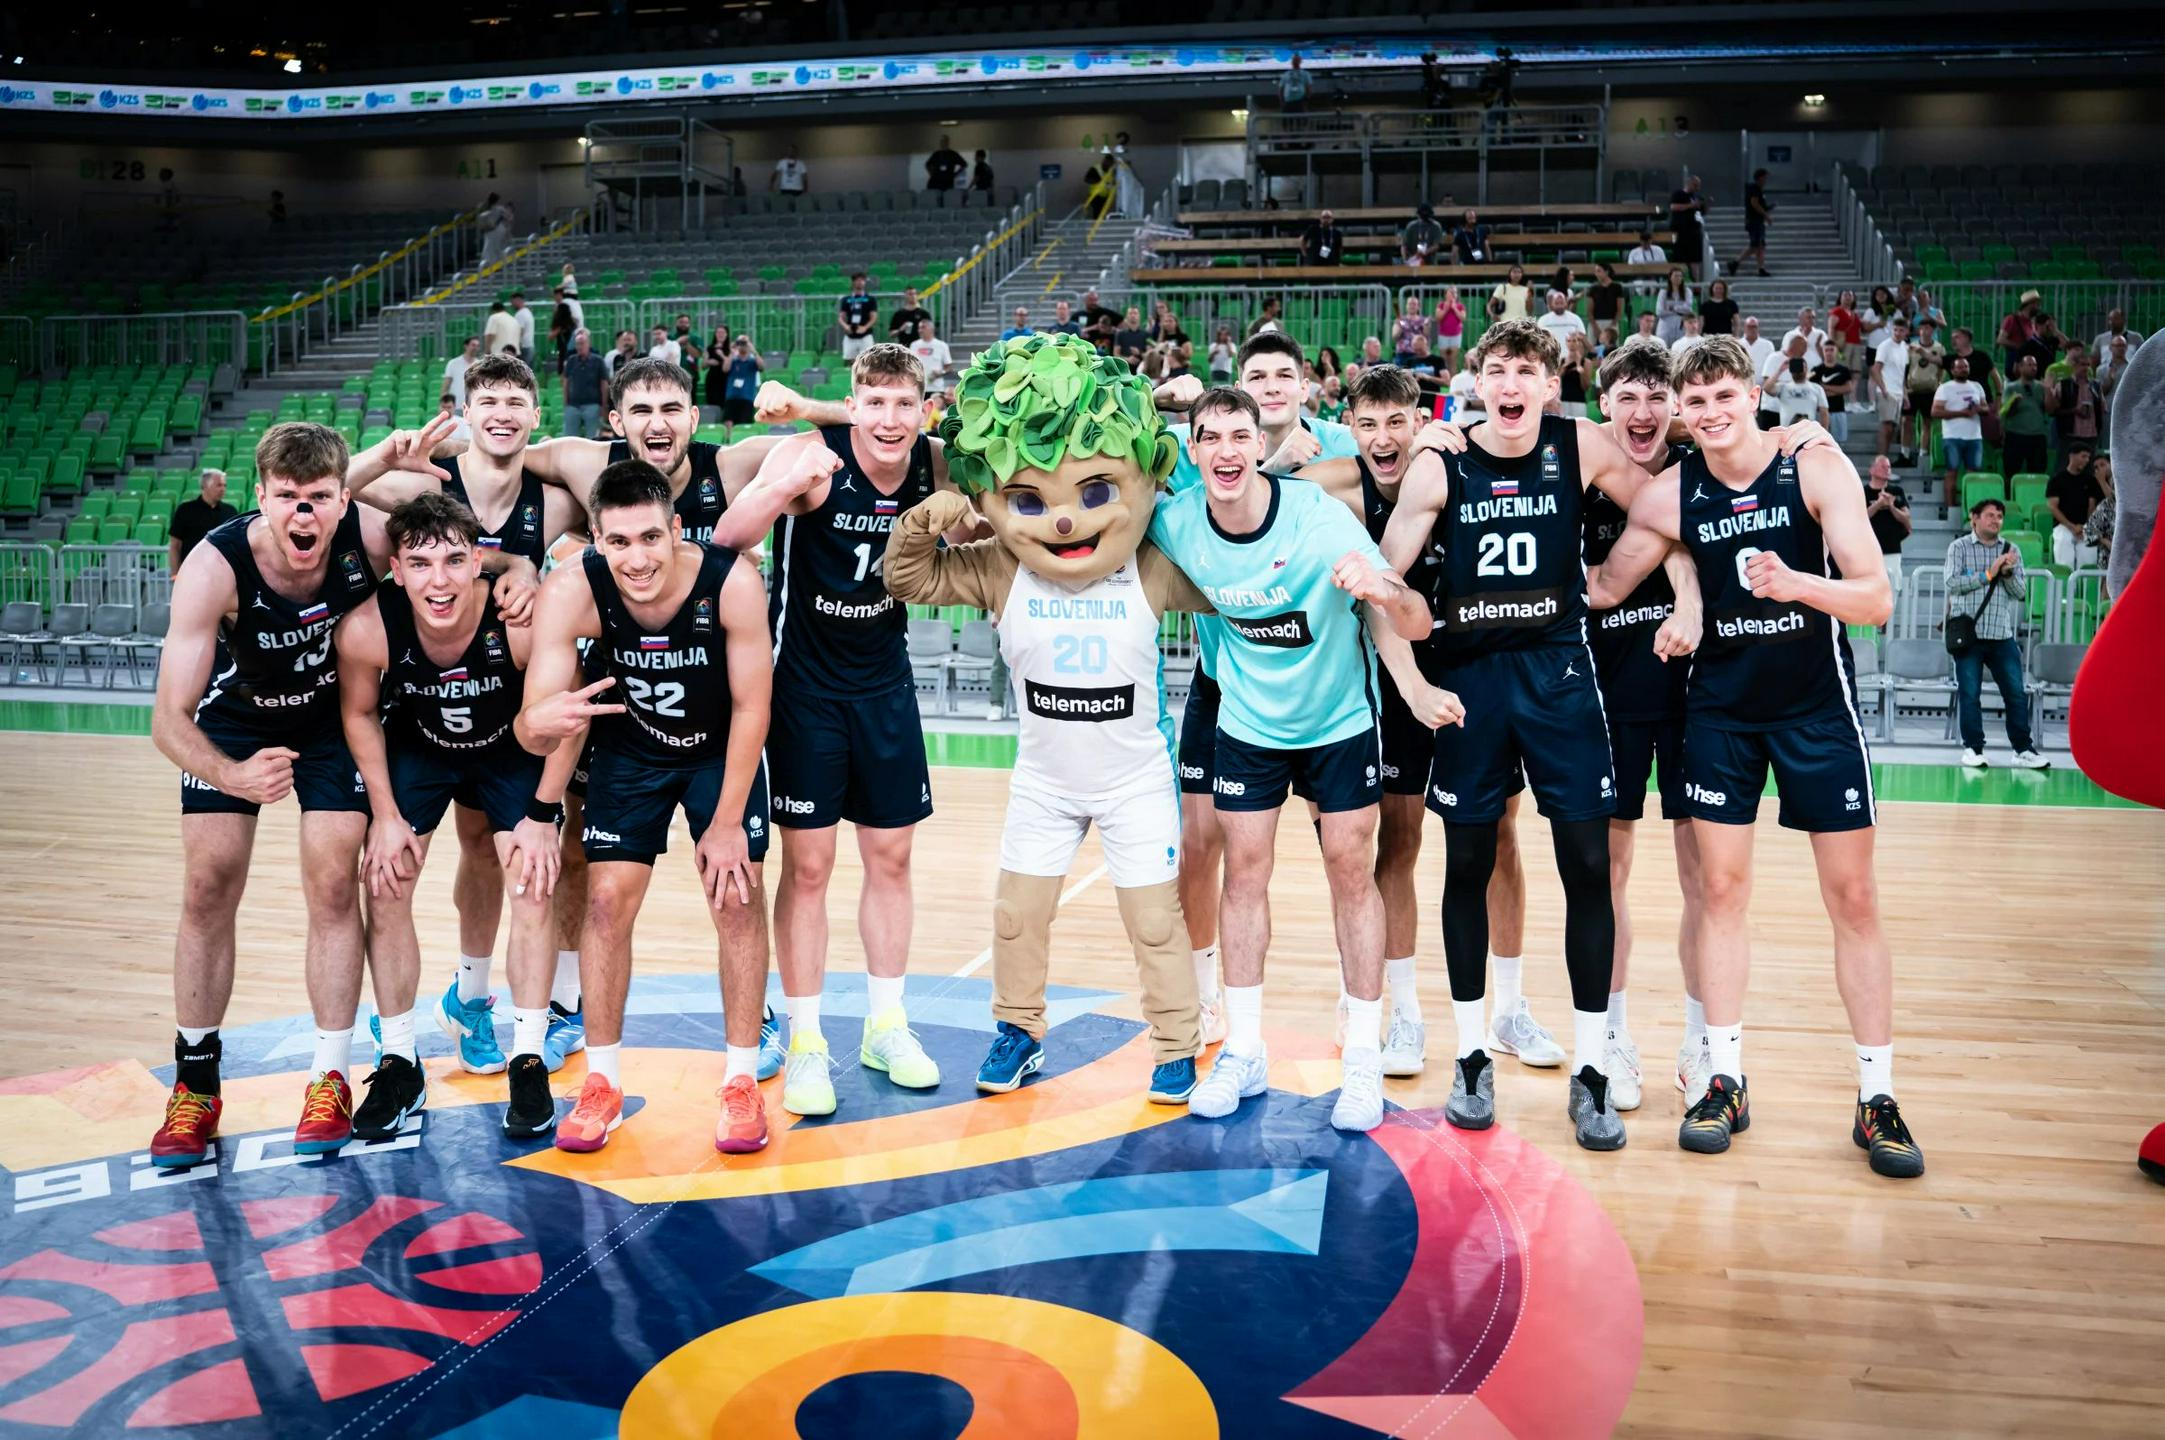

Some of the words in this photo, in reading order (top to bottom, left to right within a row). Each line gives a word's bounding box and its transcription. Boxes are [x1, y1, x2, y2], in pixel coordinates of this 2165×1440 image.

[118, 95, 140, 105] KZS
[1459, 494, 1558, 524] SLOVENIJA
[832, 512, 898, 533] SLOVE
[1697, 506, 1791, 543] SLOVENIJA
[1477, 532, 1537, 577] 20
[815, 593, 895, 619] telemach
[1028, 598, 1128, 620] SLOVENIJA
[1458, 596, 1558, 623] telemach
[1601, 603, 1674, 629] telemac
[258, 612, 344, 650] SLOVE
[1228, 619, 1301, 639] lemach
[614, 646, 709, 670] LOVENIJA
[1053, 634, 1108, 675] 20
[624, 676, 686, 718] 22
[1033, 691, 1126, 714] telemach
[441, 707, 473, 733] 5
[624, 697, 708, 748] emach
[1180, 761, 1205, 780] hse
[1381, 763, 1401, 778] se
[191, 775, 219, 791] hs
[354, 784, 366, 793] KZ
[1218, 776, 1246, 796] hse
[785, 795, 816, 814] hse
[1693, 783, 1727, 807] hse
[1845, 801, 1861, 811] KZS
[750, 828, 764, 839] KZS
